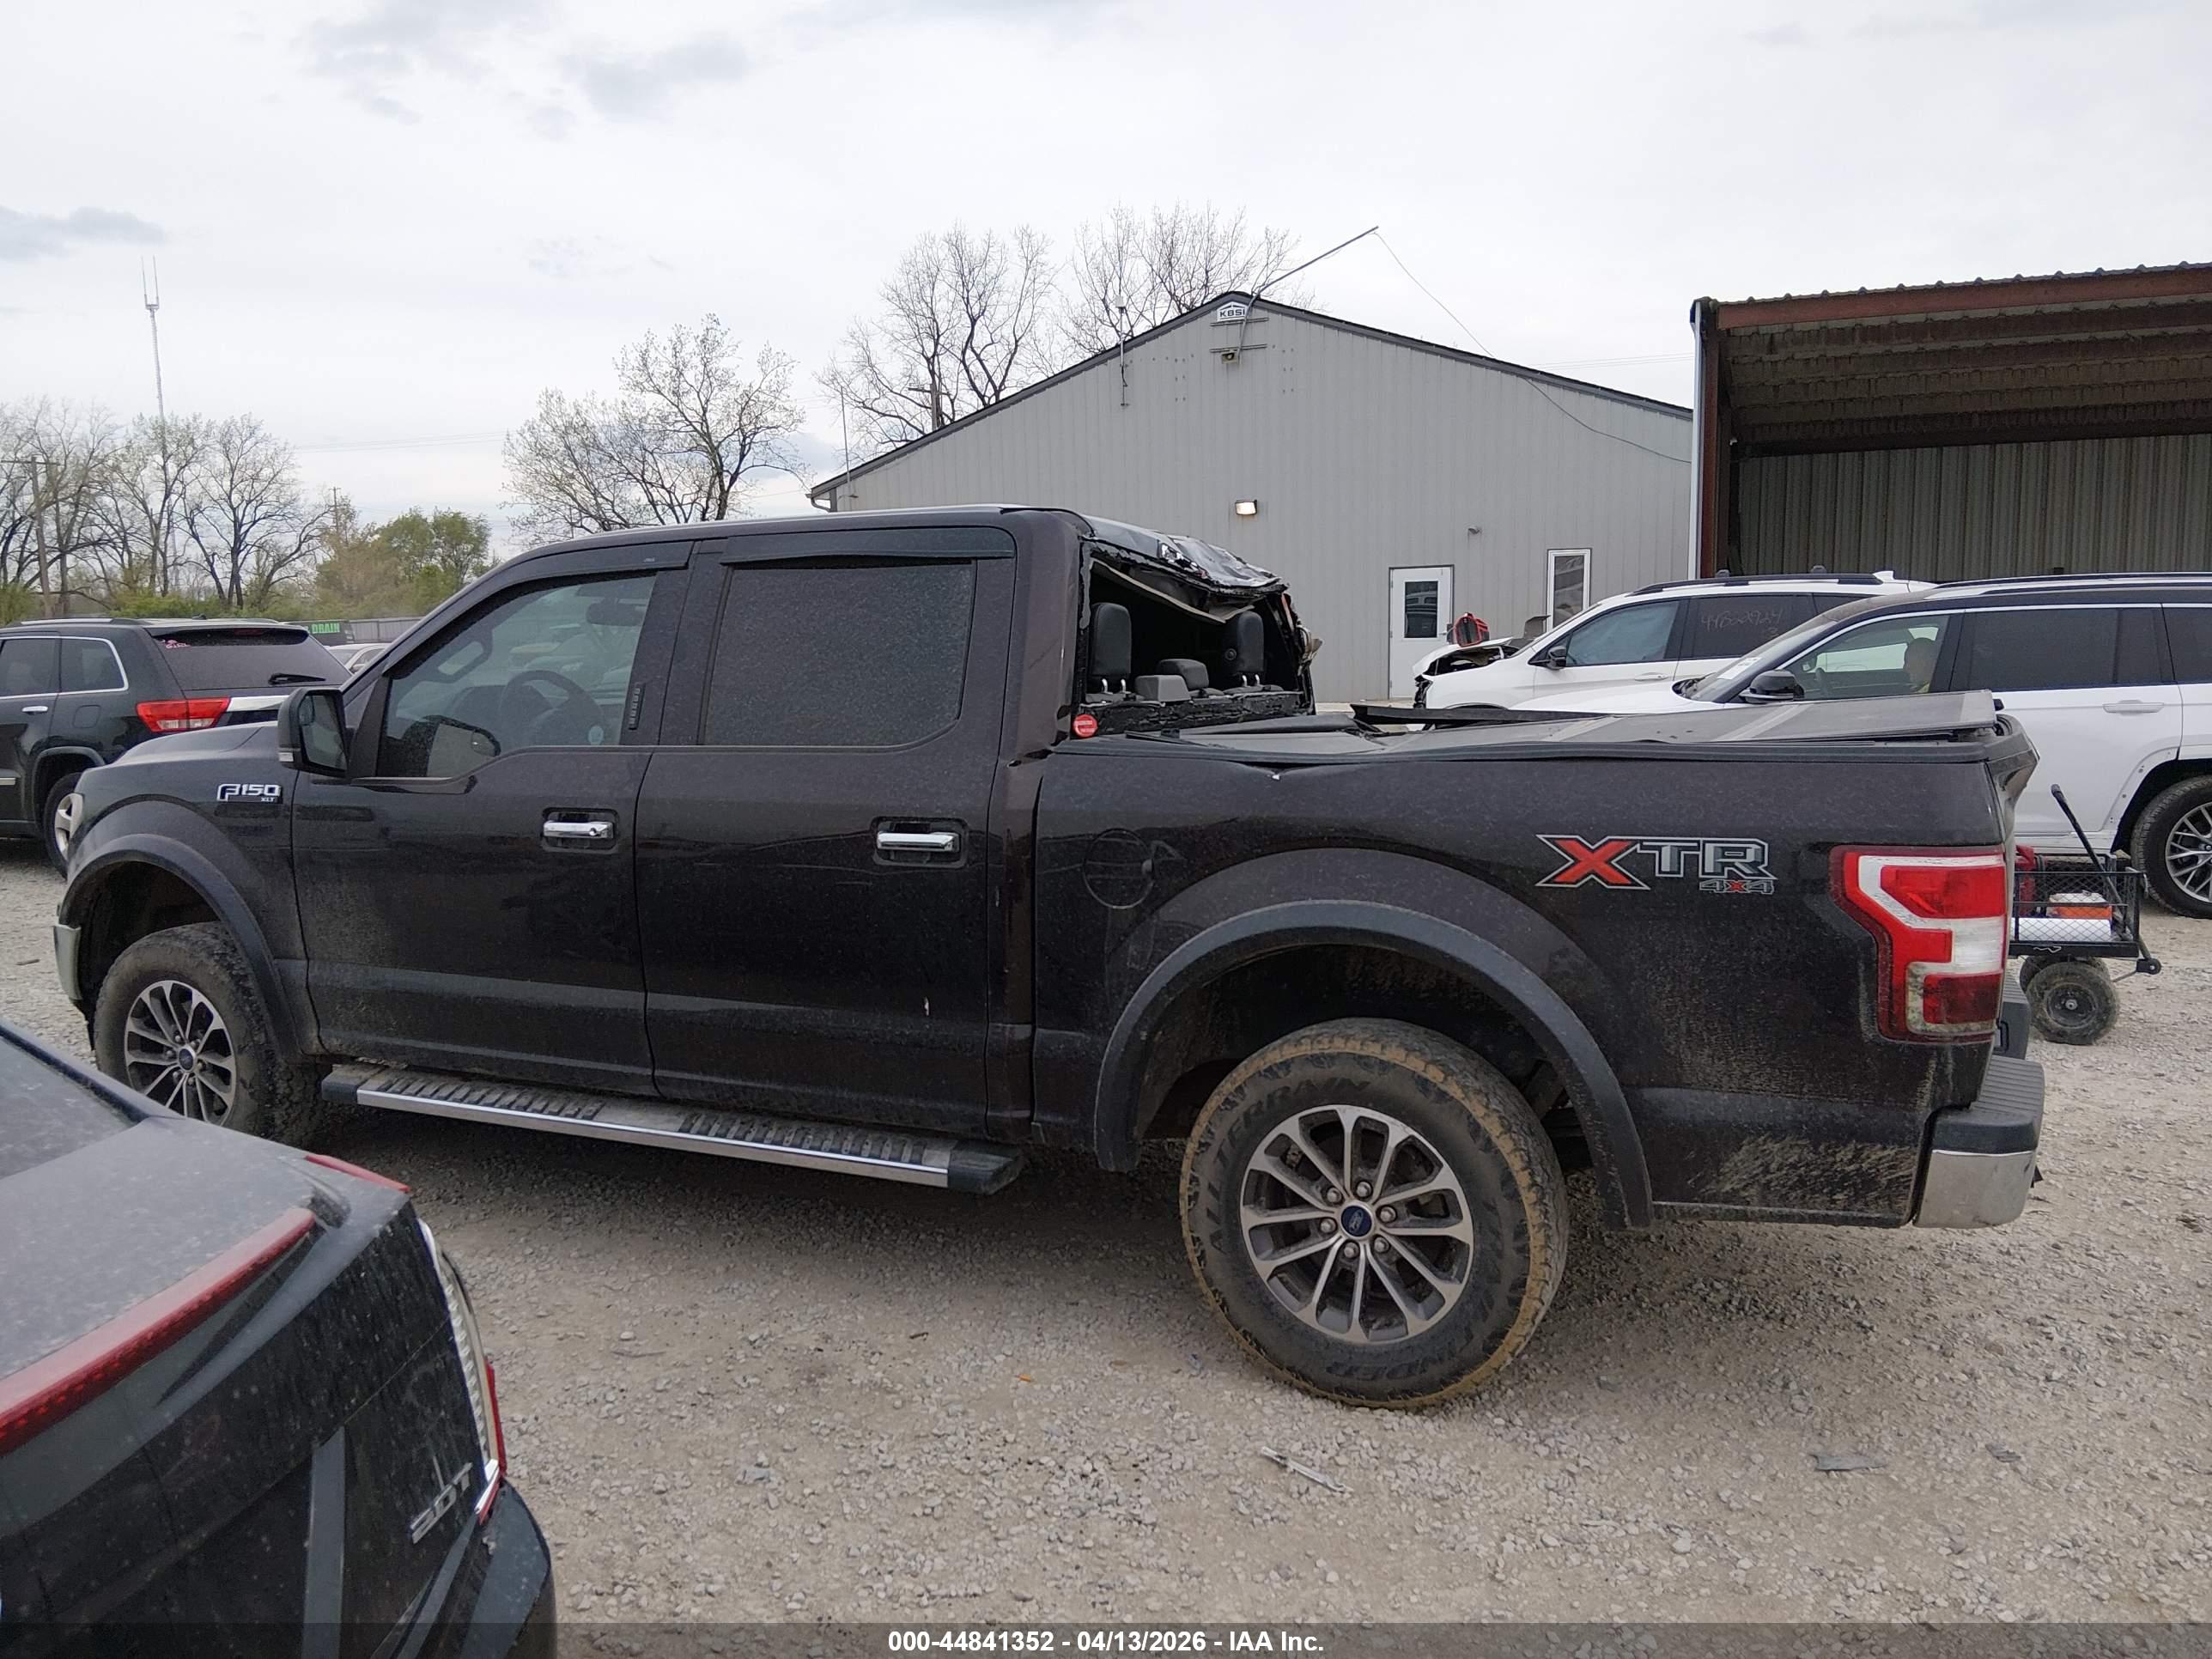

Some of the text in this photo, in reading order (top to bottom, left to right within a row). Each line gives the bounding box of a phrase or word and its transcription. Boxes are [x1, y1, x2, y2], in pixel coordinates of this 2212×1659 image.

[1219, 308, 1246, 318] KBSI
[311, 623, 341, 635] DRAIN
[1535, 834, 1778, 891] XTR
